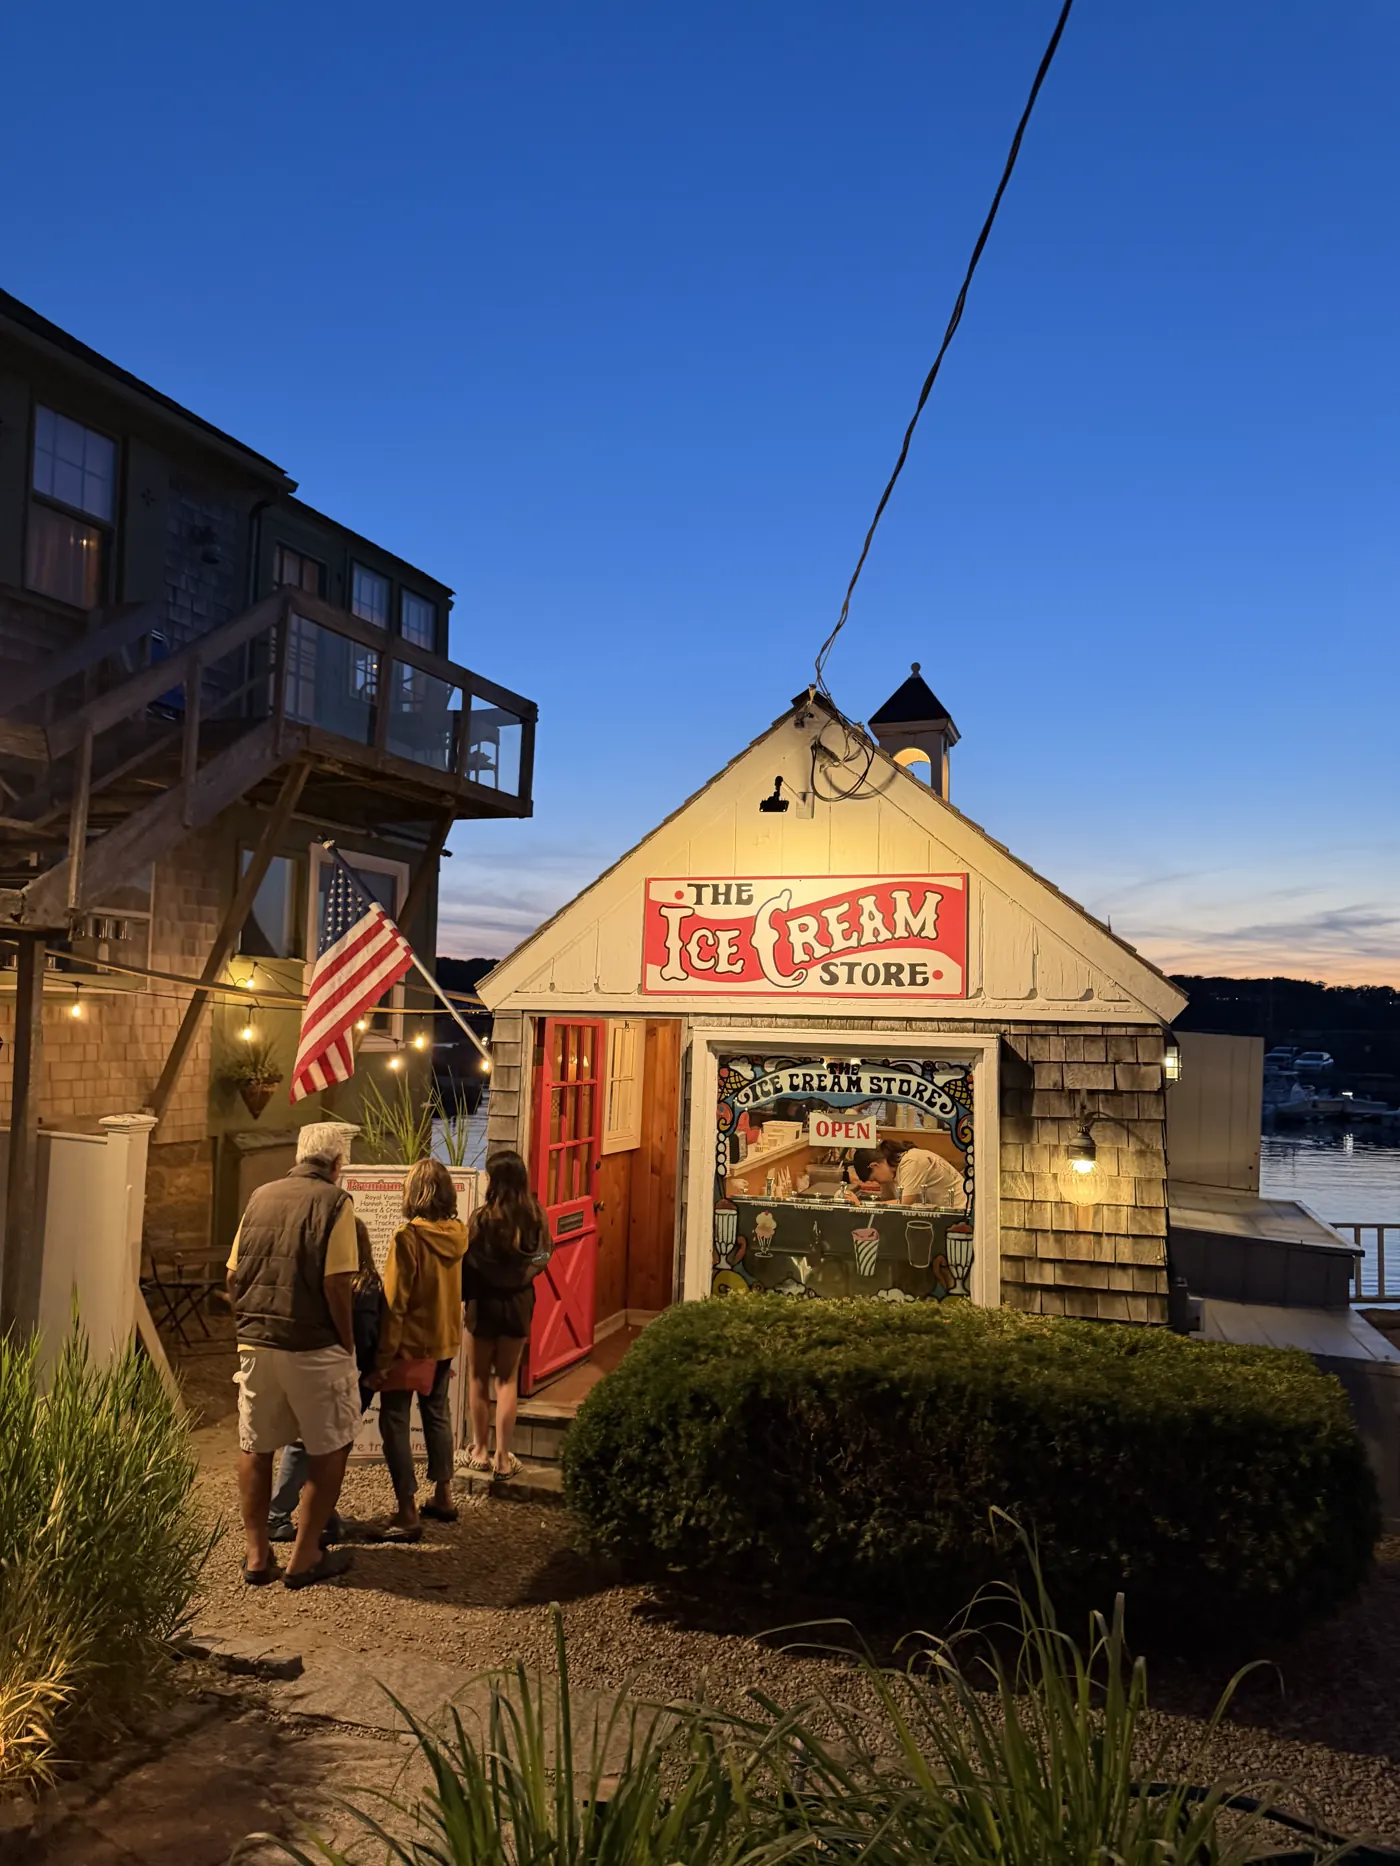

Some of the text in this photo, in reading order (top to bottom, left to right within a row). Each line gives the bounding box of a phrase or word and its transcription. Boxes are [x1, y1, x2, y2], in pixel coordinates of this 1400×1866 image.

[687, 883, 754, 906] THE
[659, 888, 944, 988] ICE CREAM
[819, 962, 929, 986] STORE
[826, 1062, 861, 1075] THE
[749, 1073, 942, 1108] ICE CREAM STORE
[816, 1120, 870, 1140] OPEN
